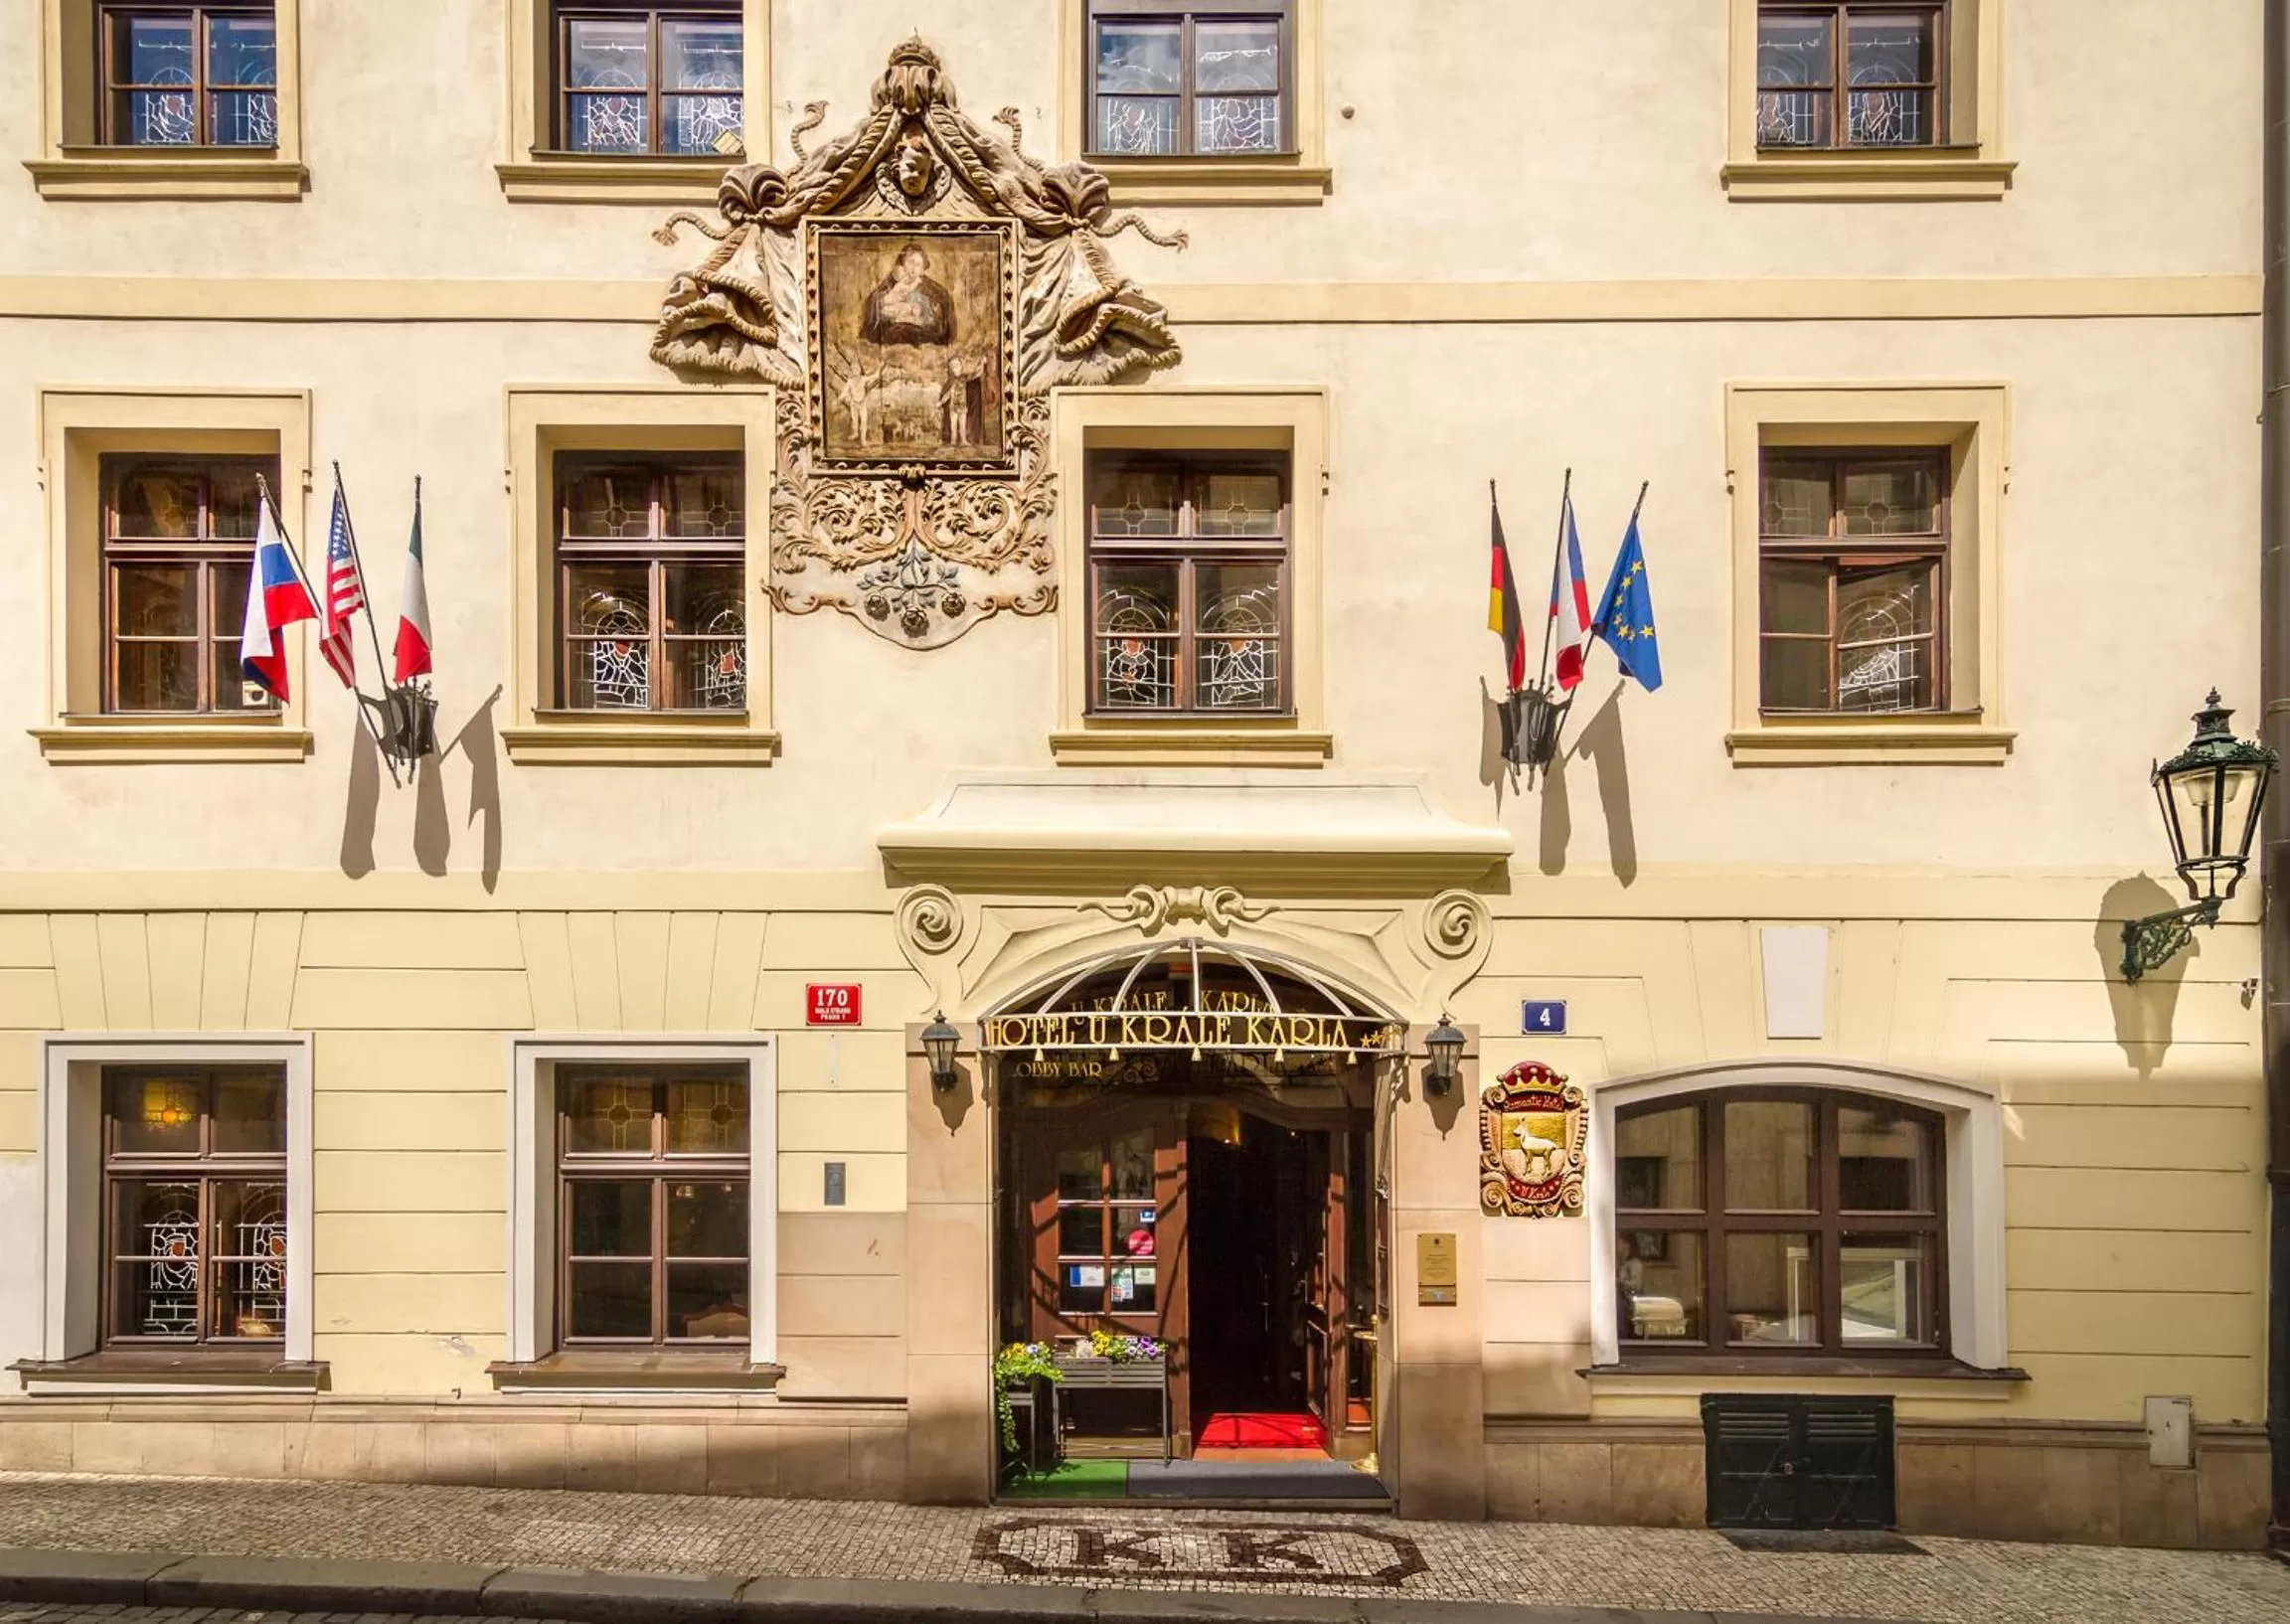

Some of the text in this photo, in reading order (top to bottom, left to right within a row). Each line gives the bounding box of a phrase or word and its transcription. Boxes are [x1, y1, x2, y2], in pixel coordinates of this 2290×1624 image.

[817, 988, 848, 1007] 170
[989, 1006, 1349, 1048] HOTEL U KRÁLE KARLA
[1540, 1008, 1551, 1027] 4
[1068, 1061, 1102, 1077] BAR
